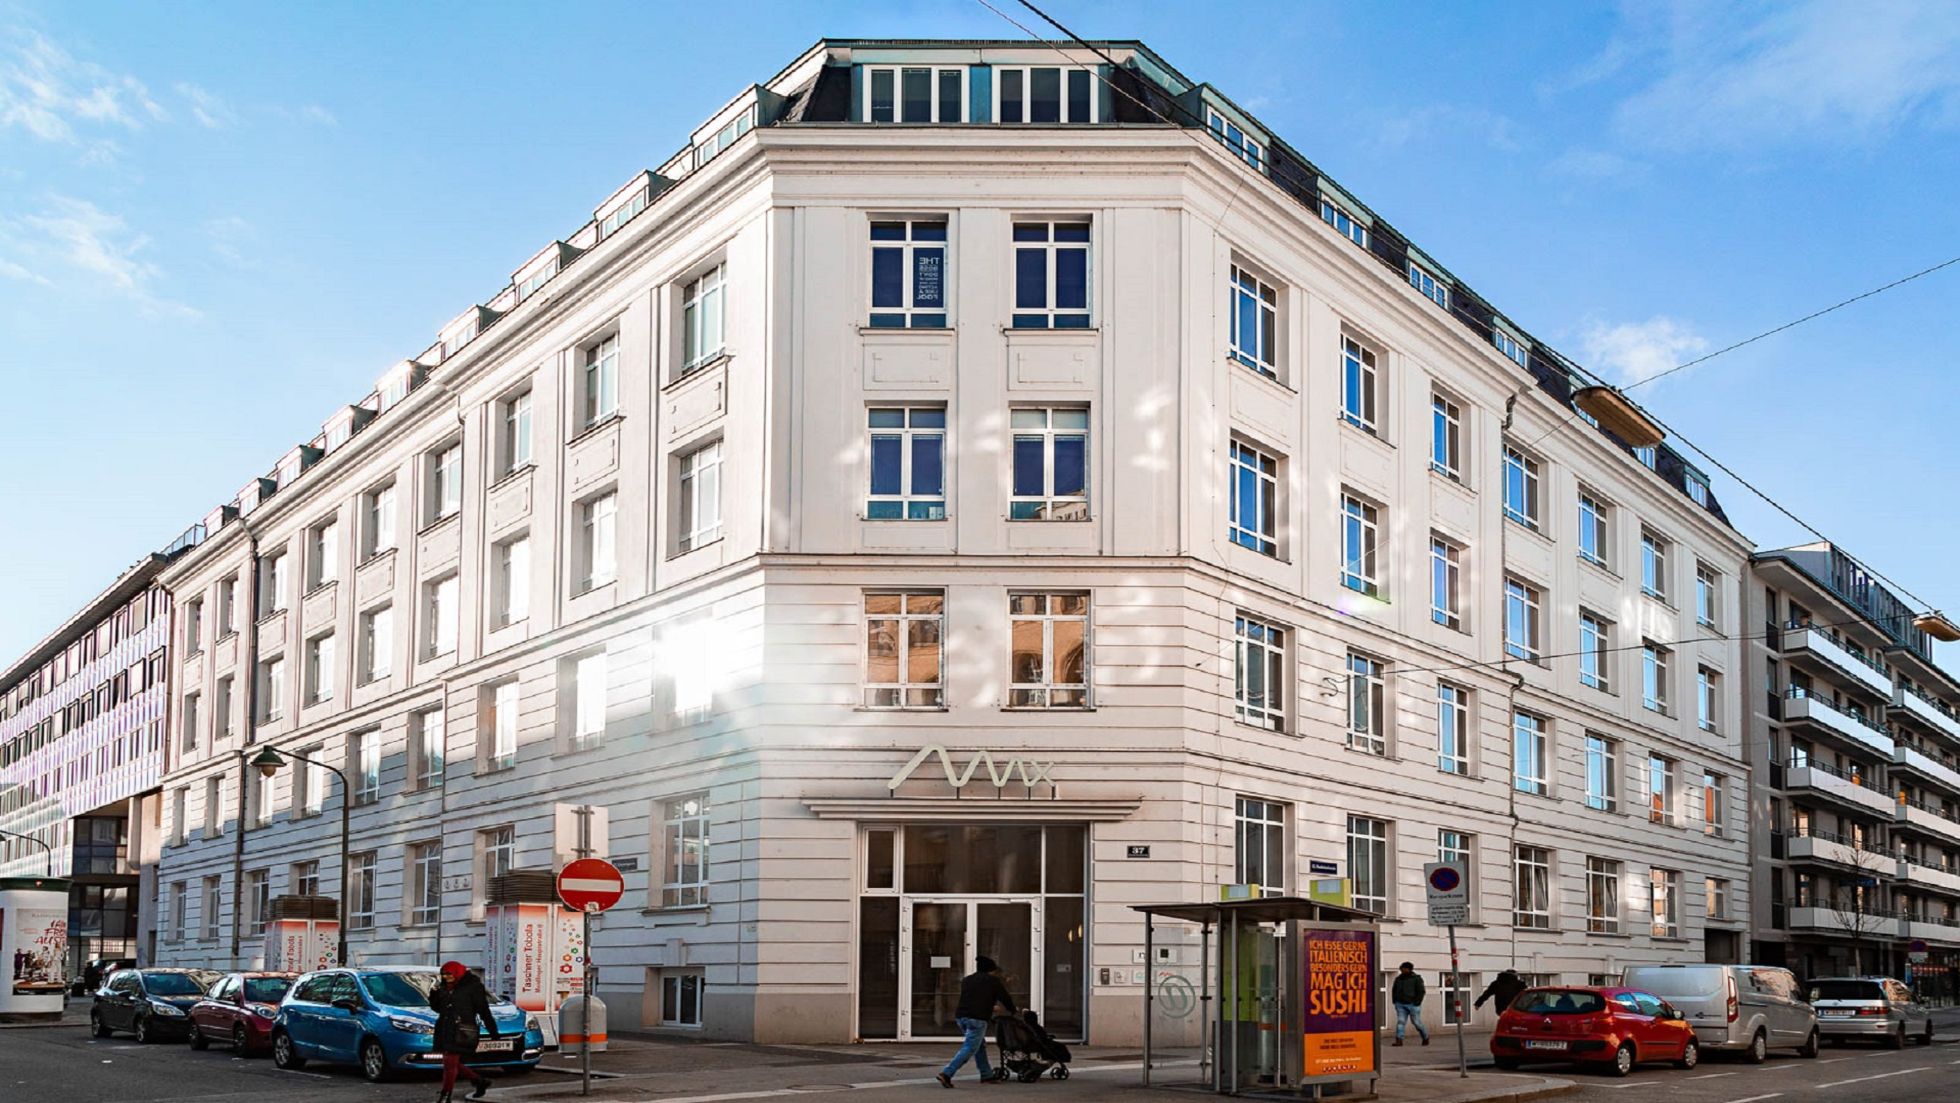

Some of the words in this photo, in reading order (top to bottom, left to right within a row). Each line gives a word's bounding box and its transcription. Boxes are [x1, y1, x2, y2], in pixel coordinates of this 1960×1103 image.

[1131, 847, 1145, 855] 37
[523, 924, 533, 952] Tobola
[1310, 940, 1323, 950] ICH
[1325, 940, 1342, 950] ESSE
[1343, 941, 1367, 950] GERNE
[1310, 950, 1367, 963] ITALIENISCH
[1310, 963, 1349, 973] BESONDERS
[1311, 972, 1343, 989] MAG
[1346, 973, 1367, 989] ICH
[1310, 990, 1366, 1014] SUSHI
